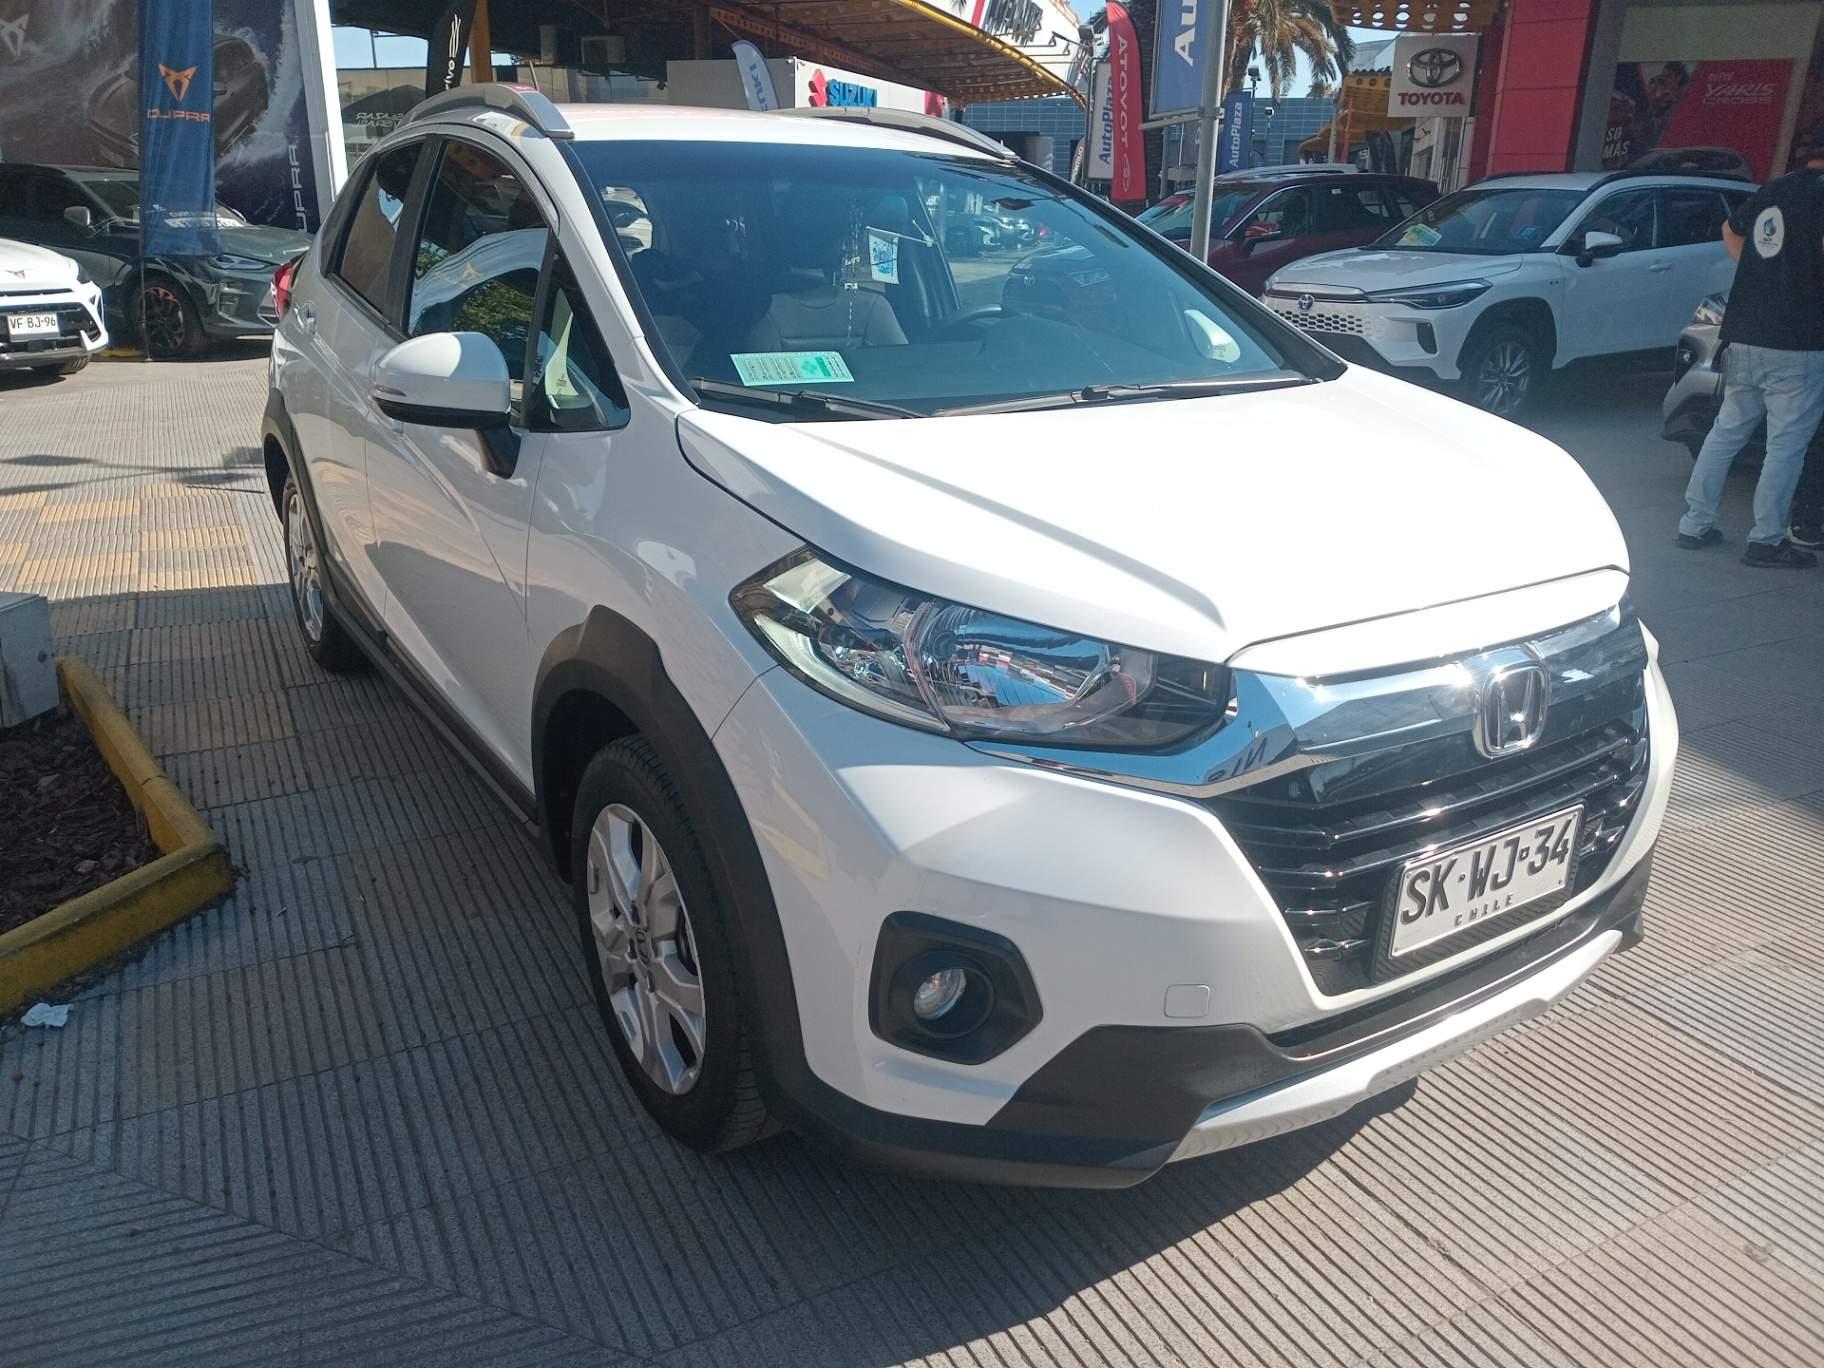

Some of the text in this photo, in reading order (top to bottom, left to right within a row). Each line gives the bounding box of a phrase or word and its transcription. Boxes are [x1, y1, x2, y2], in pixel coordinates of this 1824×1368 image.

[828, 78, 878, 108] SUZUKI
[1398, 92, 1465, 106] TOYOTA
[1704, 82, 1777, 97] YARIS
[146, 108, 211, 123] CUPRA
[1098, 75, 1113, 165] AutoPlaz
[1229, 102, 1243, 168] AutoPlaza
[287, 144, 308, 233] UPRA
[1454, 893, 1514, 927] CHILE
